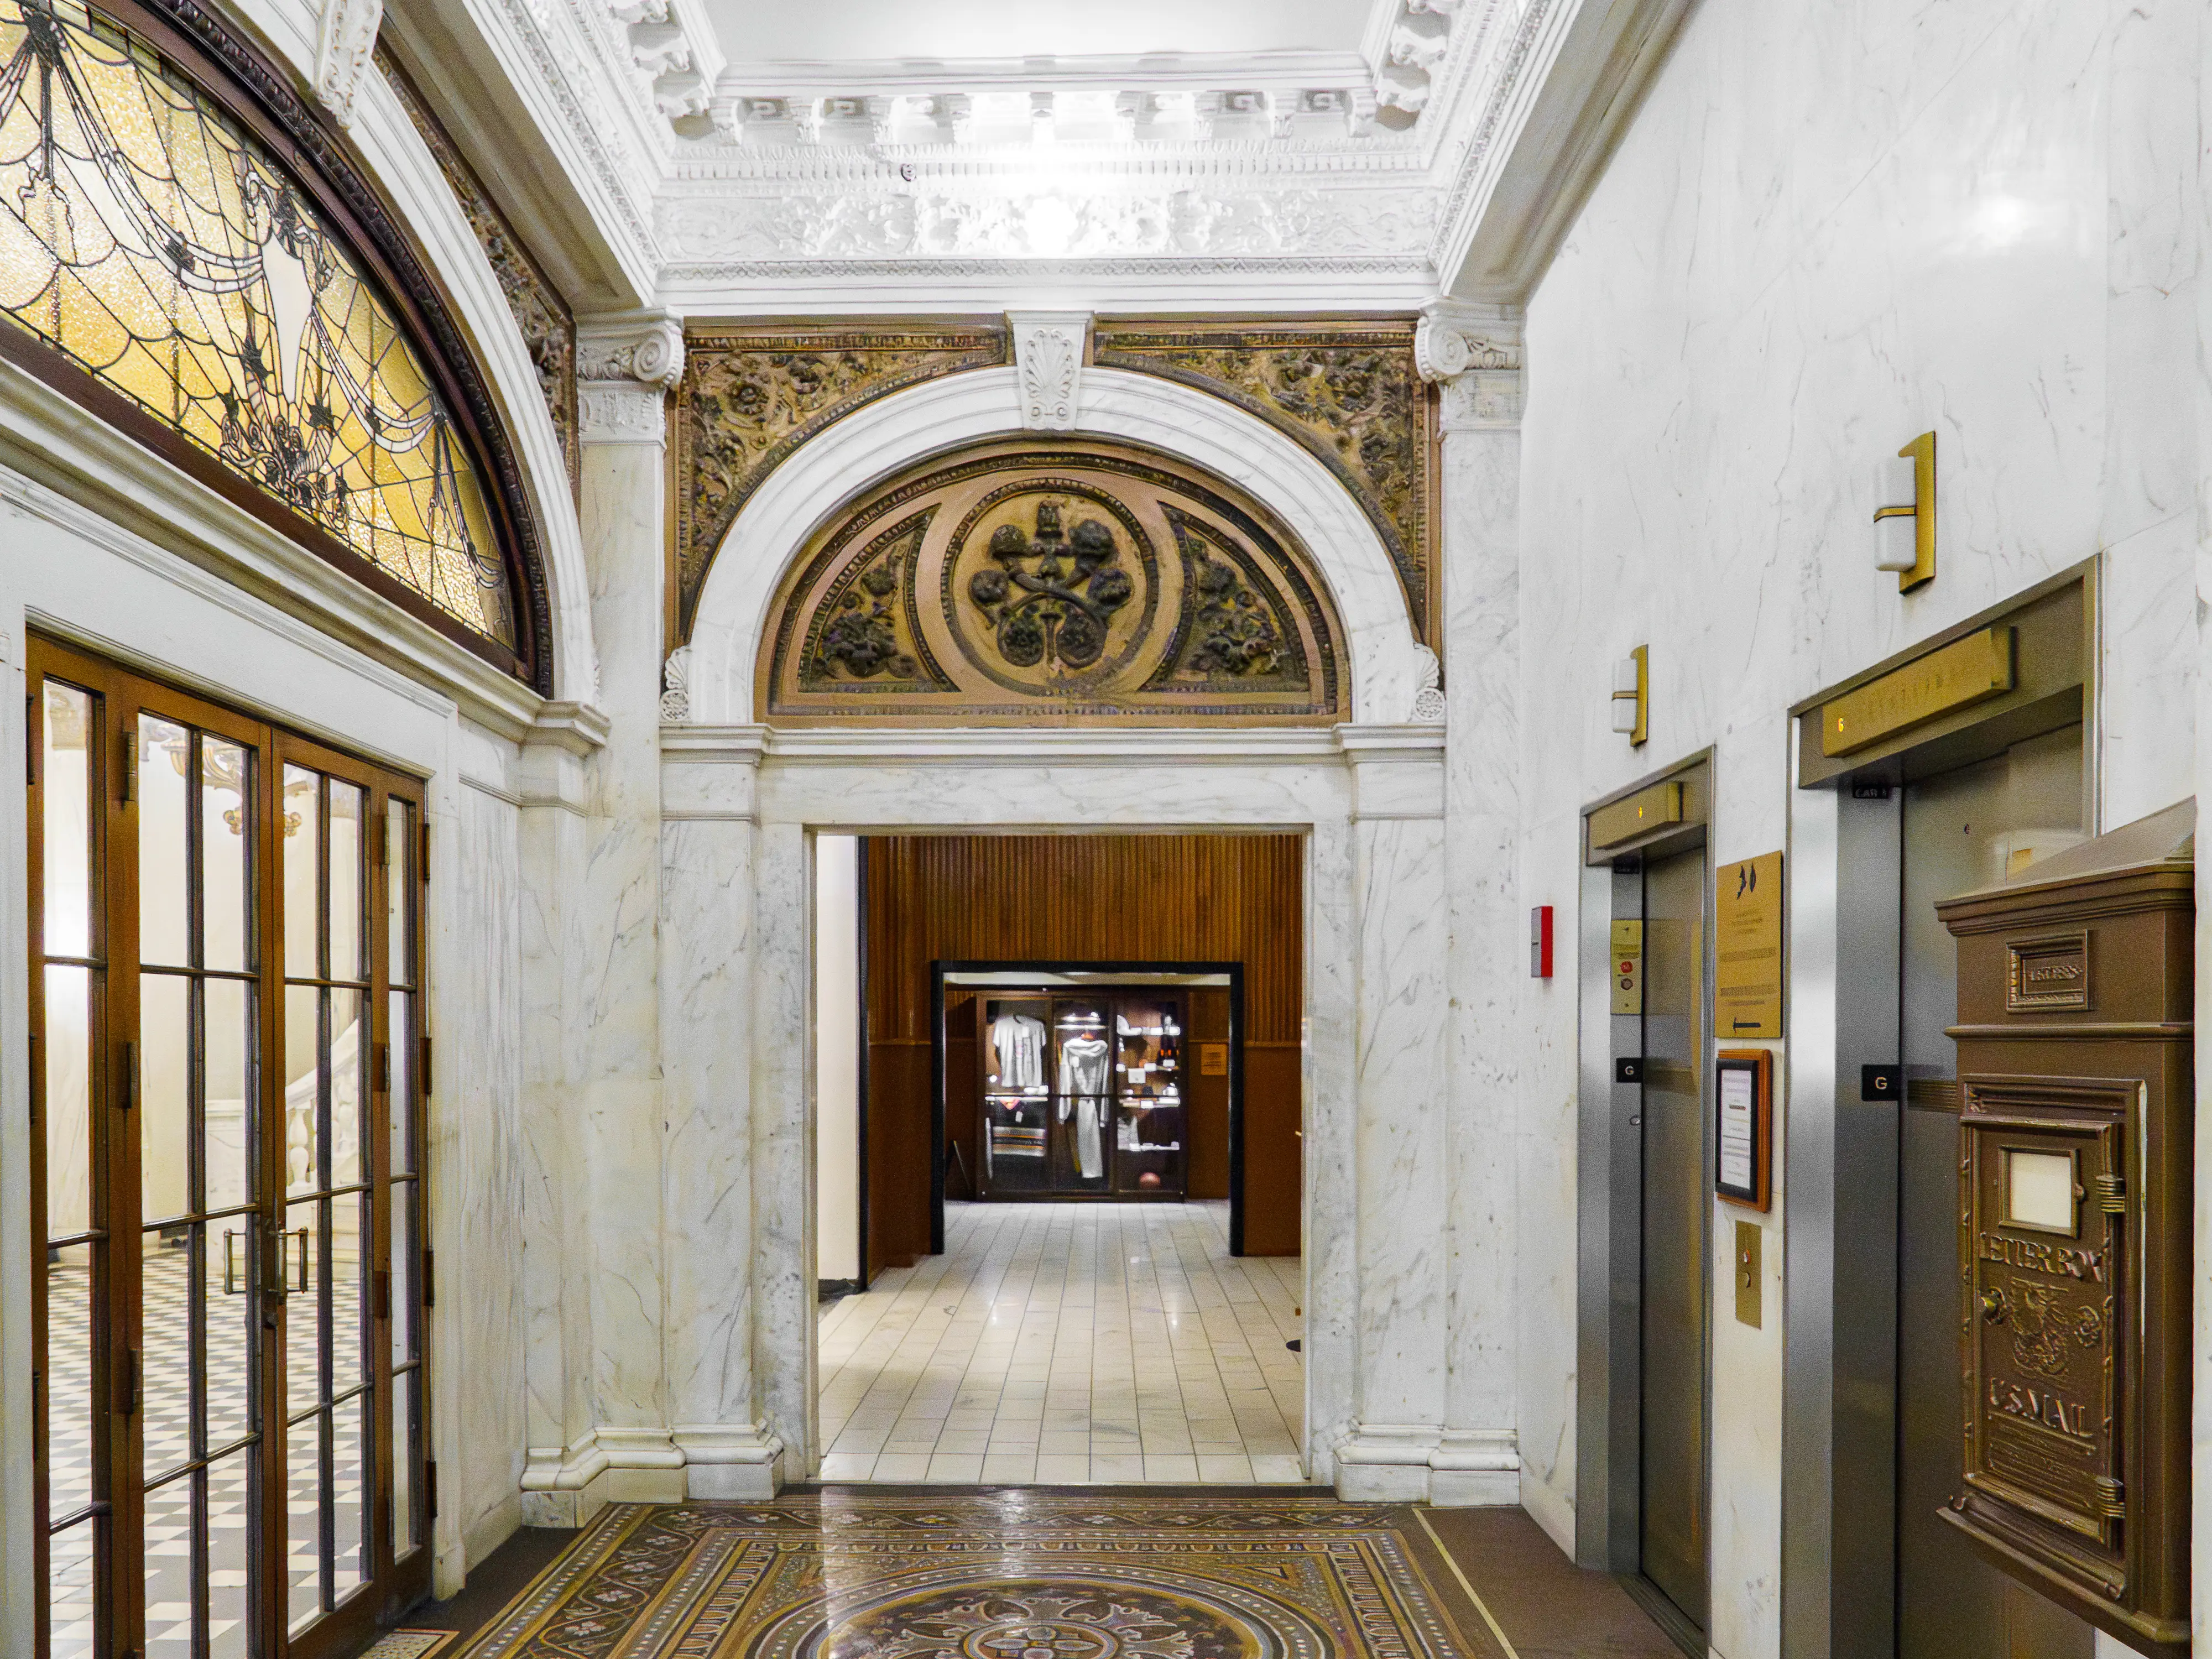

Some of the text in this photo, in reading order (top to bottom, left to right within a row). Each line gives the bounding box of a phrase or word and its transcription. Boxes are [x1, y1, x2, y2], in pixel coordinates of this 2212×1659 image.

[1625, 1066, 1635, 1076] G
[1875, 1077, 1887, 1089] G
[1979, 1231, 2103, 1283] LETTER BOX
